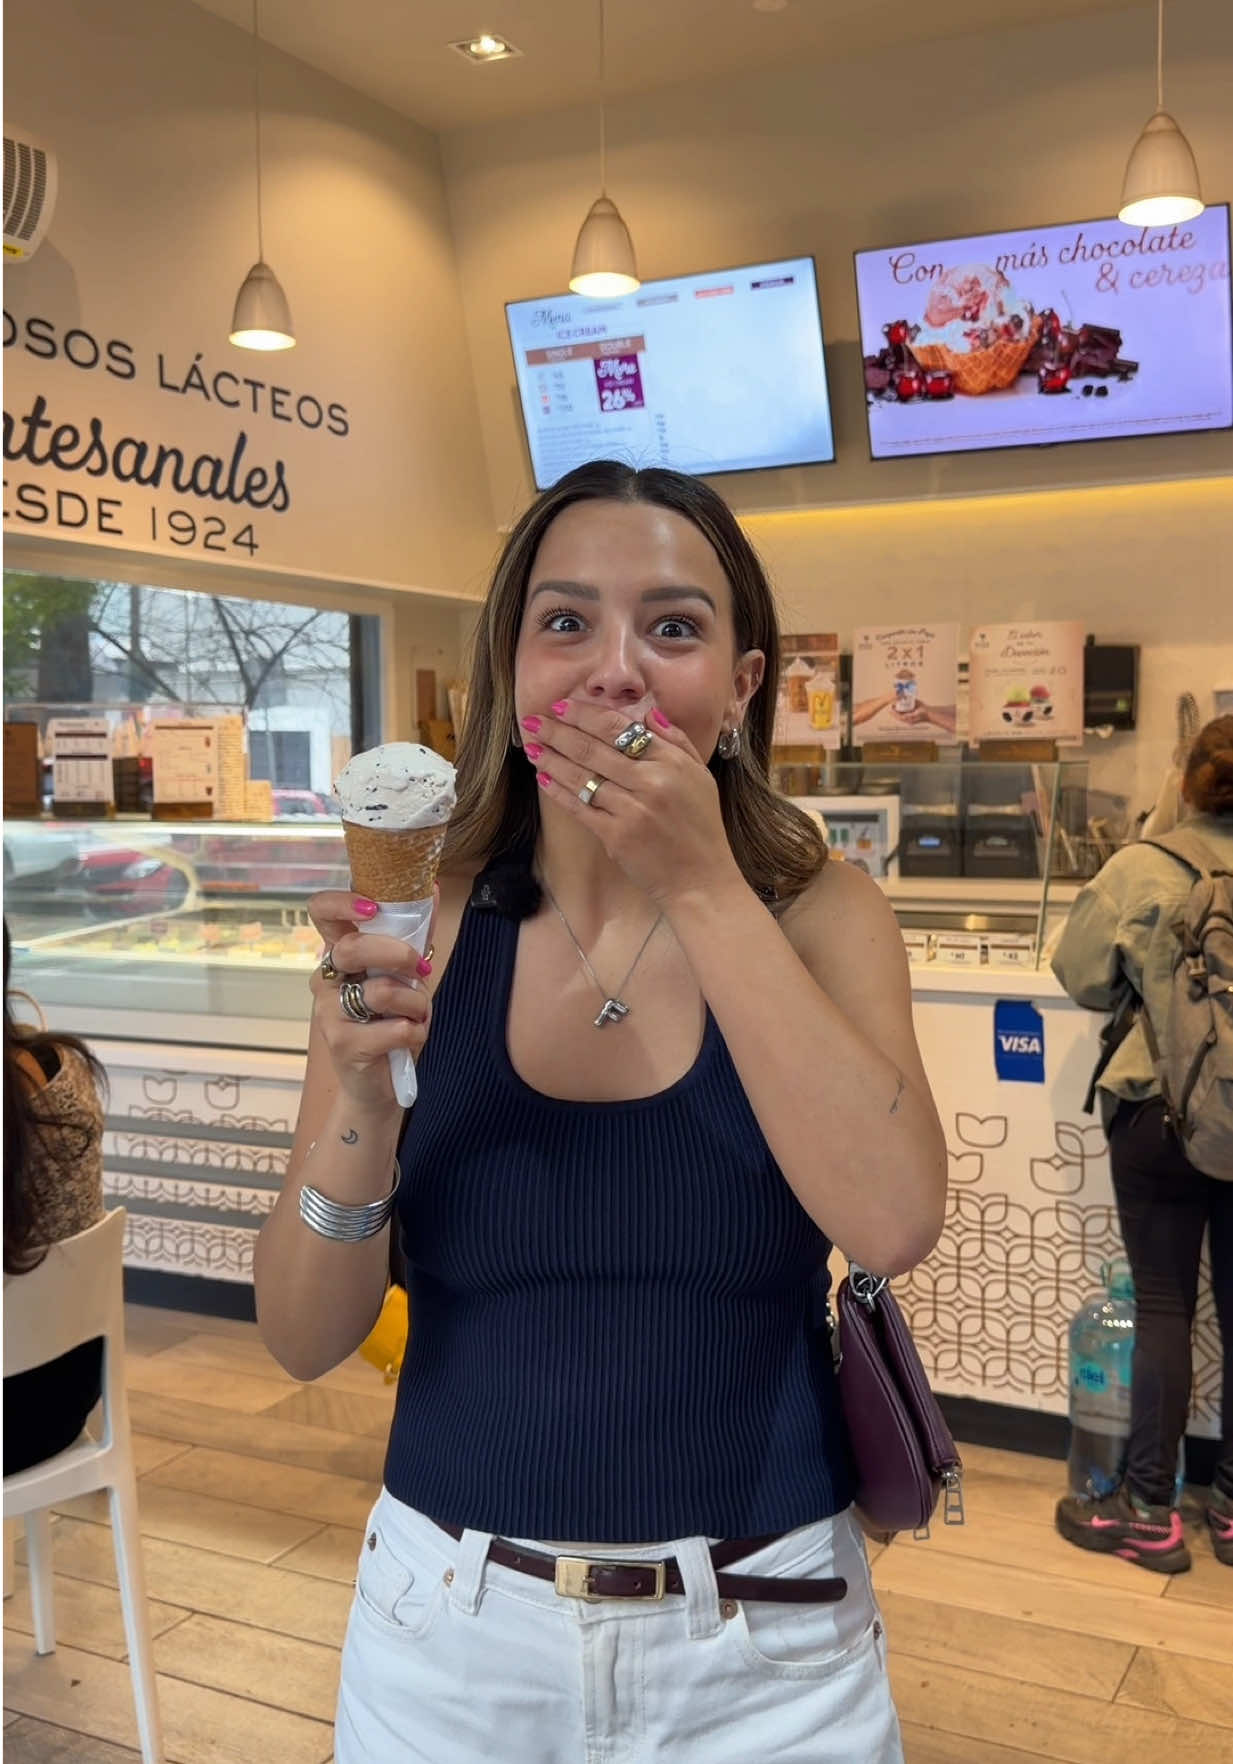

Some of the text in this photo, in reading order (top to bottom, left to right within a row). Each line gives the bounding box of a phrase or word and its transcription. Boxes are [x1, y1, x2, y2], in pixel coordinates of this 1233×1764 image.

[889, 226, 1195, 284] Con más chocolate
[1095, 262, 1119, 296] &
[159, 353, 349, 436] LÁCTEOS
[3, 480, 259, 556] SDE 1924
[998, 1035, 1042, 1054] VISA
